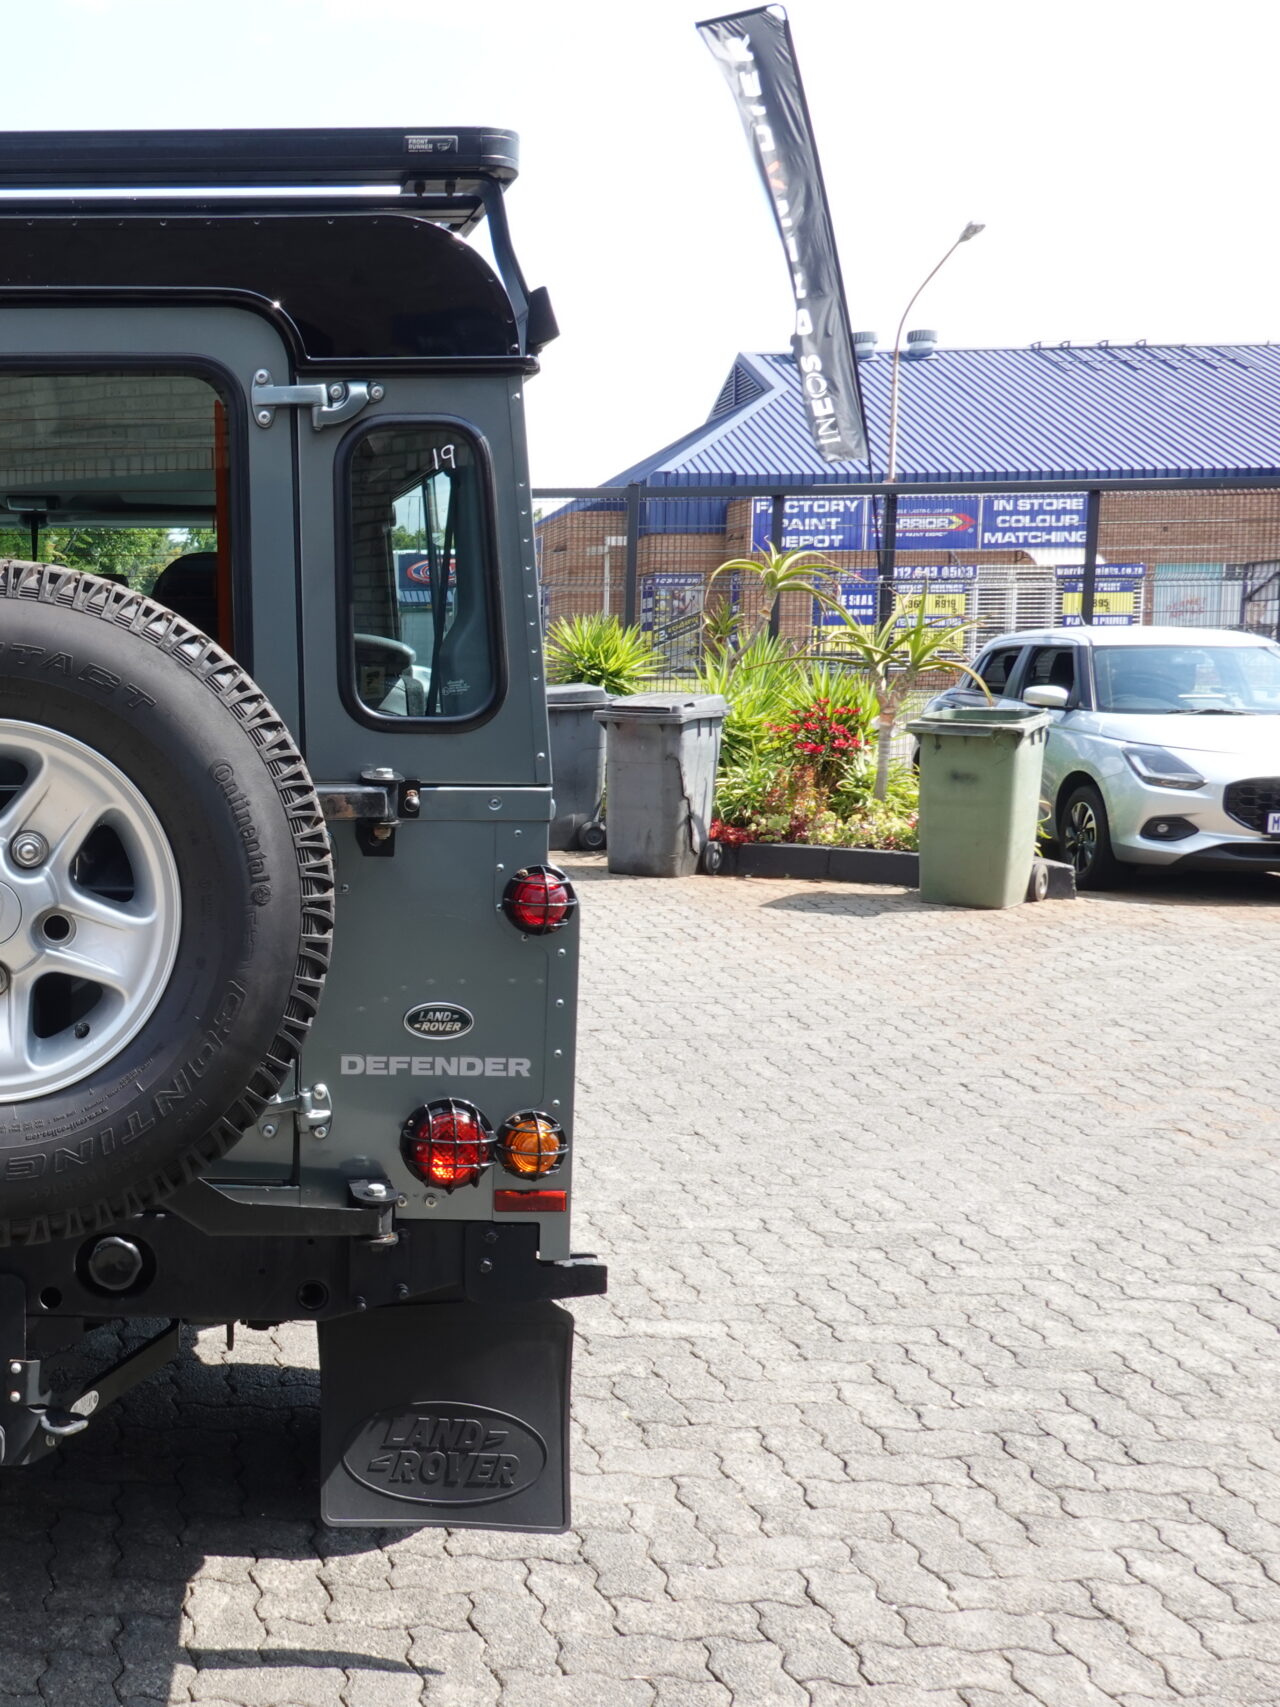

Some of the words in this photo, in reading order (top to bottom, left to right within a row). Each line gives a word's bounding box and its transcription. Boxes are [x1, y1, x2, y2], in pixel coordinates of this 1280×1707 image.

[801, 353, 841, 445] INEOS
[431, 444, 456, 469] 19
[993, 498, 1016, 511] IN
[1017, 498, 1084, 511] STORE
[871, 516, 949, 530] RRIOR
[996, 514, 1080, 528] COLOUR
[781, 535, 844, 548] EPOT
[418, 1011, 452, 1022] LAND
[421, 1021, 462, 1031] ROVER
[340, 1054, 532, 1077] DEFENDER
[379, 1416, 485, 1450] LAND
[388, 1449, 521, 1488] ROVER
